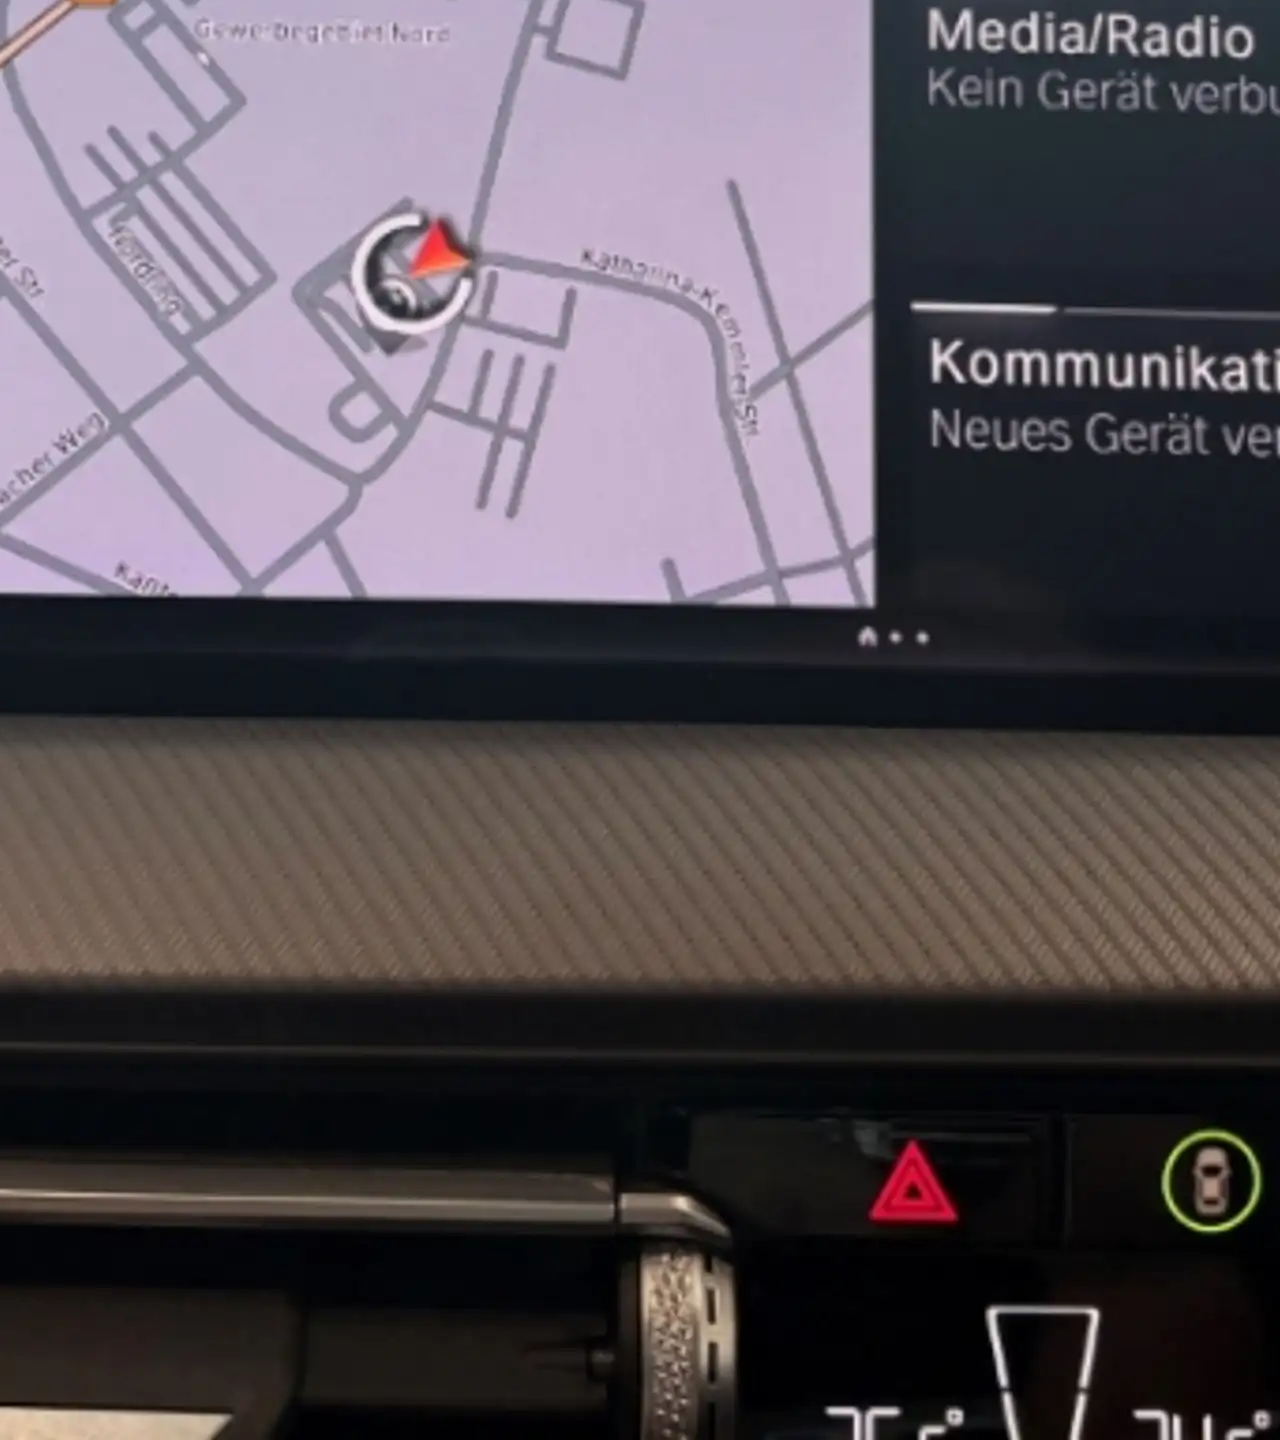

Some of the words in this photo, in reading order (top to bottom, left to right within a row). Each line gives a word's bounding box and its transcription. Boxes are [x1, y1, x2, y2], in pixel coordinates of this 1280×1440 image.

[928, 7, 1256, 60] Media/Radio
[927, 66, 1023, 109] Kein
[1036, 70, 1158, 112] Gerät
[50, 411, 108, 456] Weg
[930, 408, 1073, 452] Neues
[1084, 412, 1210, 456] Gerät
